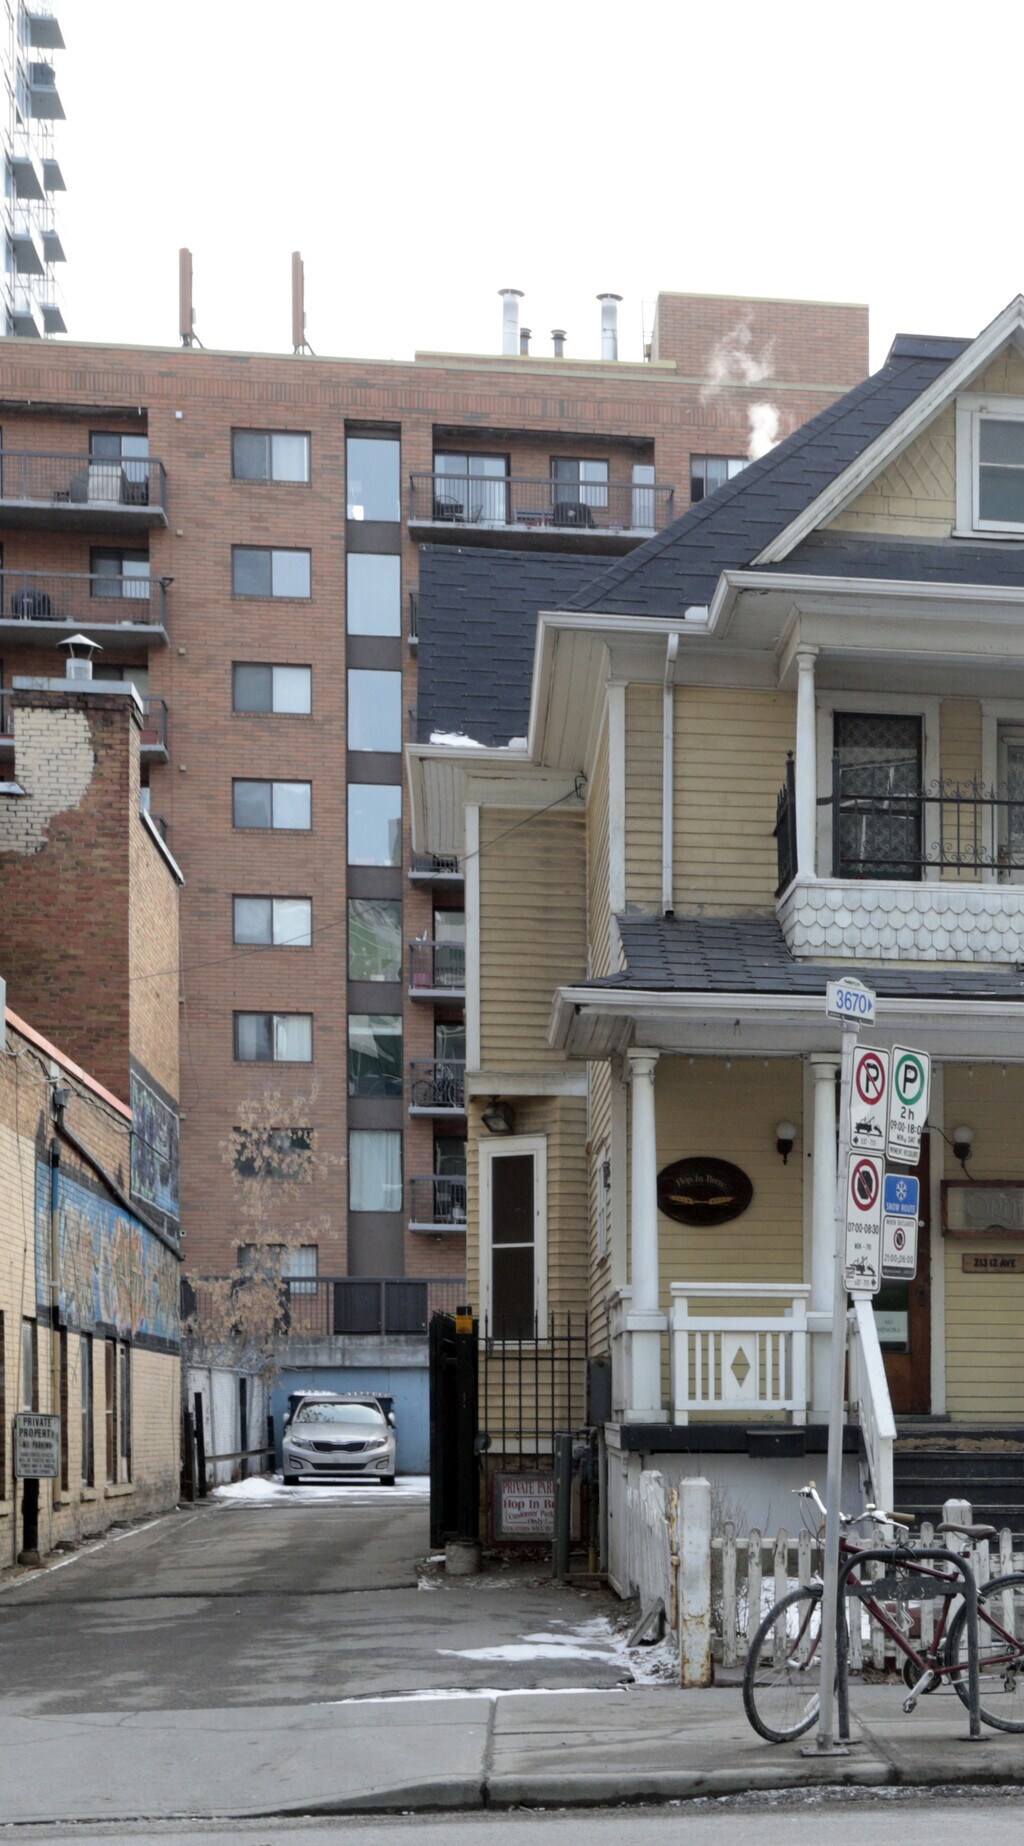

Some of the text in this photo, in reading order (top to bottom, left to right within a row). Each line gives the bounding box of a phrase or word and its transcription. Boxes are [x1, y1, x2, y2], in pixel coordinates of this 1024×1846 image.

[836, 989, 867, 1014] 3670
[903, 1064, 918, 1094] P
[890, 1119, 922, 1135] 09:00-18:0
[886, 1202, 916, 1214] SNOW ROUTE
[974, 1258, 1016, 1268] 213 12 AVE
[23, 1416, 52, 1427] PRIVATE
[19, 1428, 55, 1438] PROPERTY
[503, 1480, 534, 1494] PRIVATE
[503, 1499, 525, 1511] Hop
[529, 1499, 539, 1508] In
